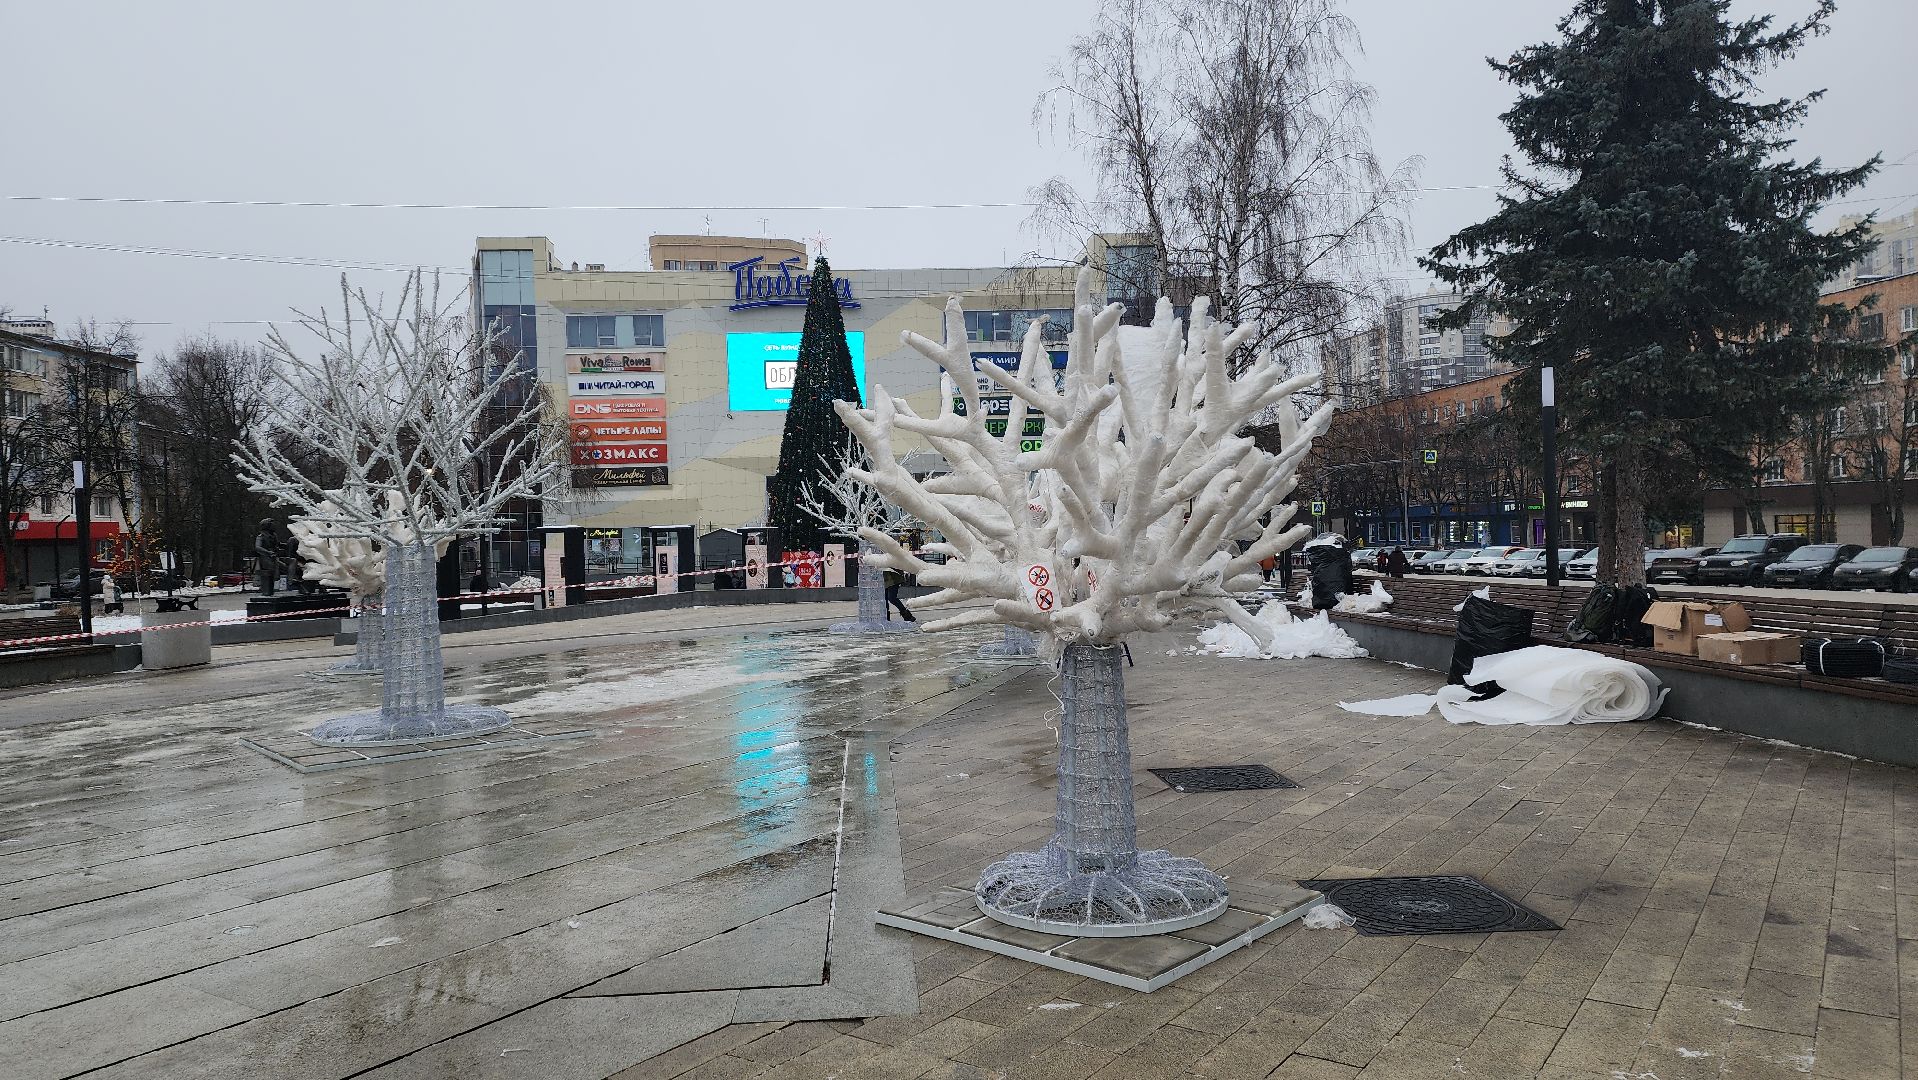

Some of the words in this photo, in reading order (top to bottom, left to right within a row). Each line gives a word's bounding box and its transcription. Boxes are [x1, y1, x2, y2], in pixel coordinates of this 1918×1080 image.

[728, 255, 854, 300] Побеа
[580, 355, 604, 368] Viva
[622, 355, 651, 367] Roma
[770, 366, 796, 383] ОБЛ
[594, 379, 655, 390] ЧИТАЙ-ГОРОД
[574, 404, 612, 414] DNS
[594, 427, 631, 435] ЧЕТЫРЕ
[632, 426, 662, 435] ЛАПЫ
[580, 448, 659, 460] ХОЗМАКС
